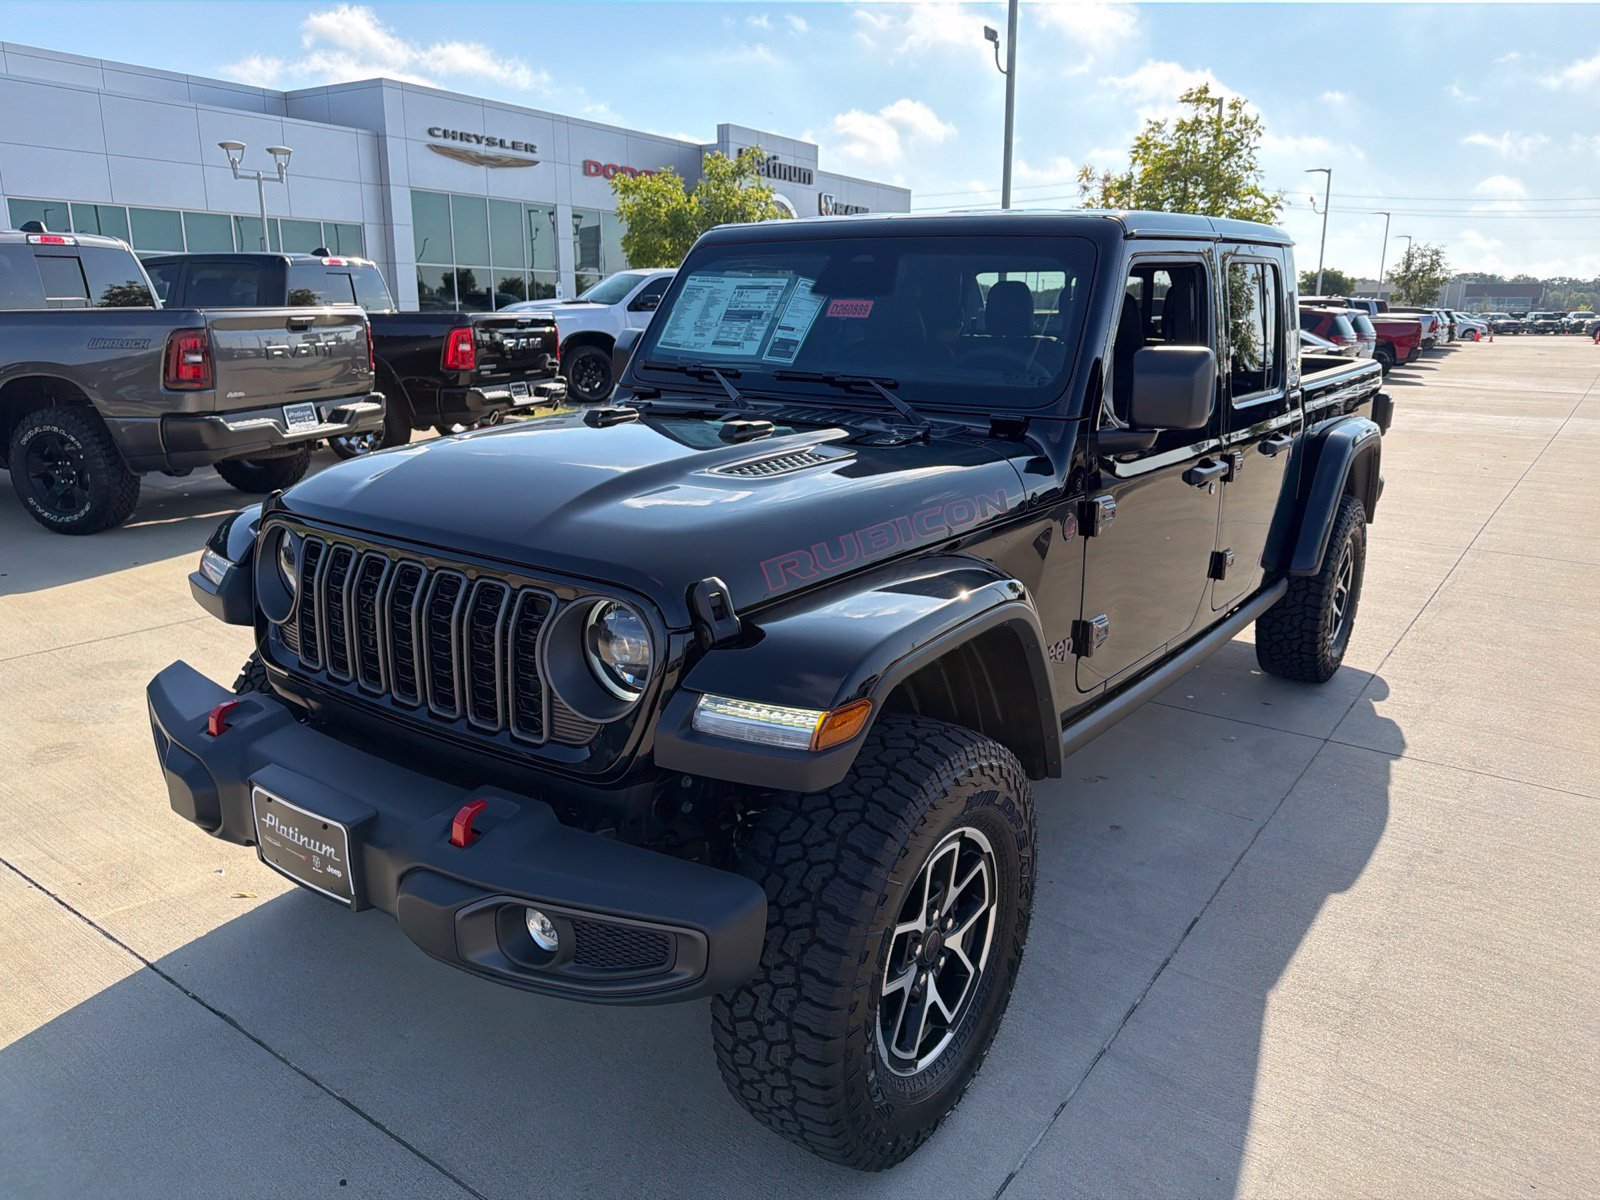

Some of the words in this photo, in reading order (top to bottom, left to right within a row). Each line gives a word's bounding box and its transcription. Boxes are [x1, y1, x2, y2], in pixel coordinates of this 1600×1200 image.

[427, 126, 538, 153] CHRYSLER
[737, 147, 814, 185] atinum
[265, 341, 337, 361] RAM
[503, 337, 541, 351] RAM
[760, 488, 1009, 592] RUBICON
[1047, 637, 1074, 663] eep
[261, 813, 340, 861] Platinum
[326, 864, 342, 878] Jeep
